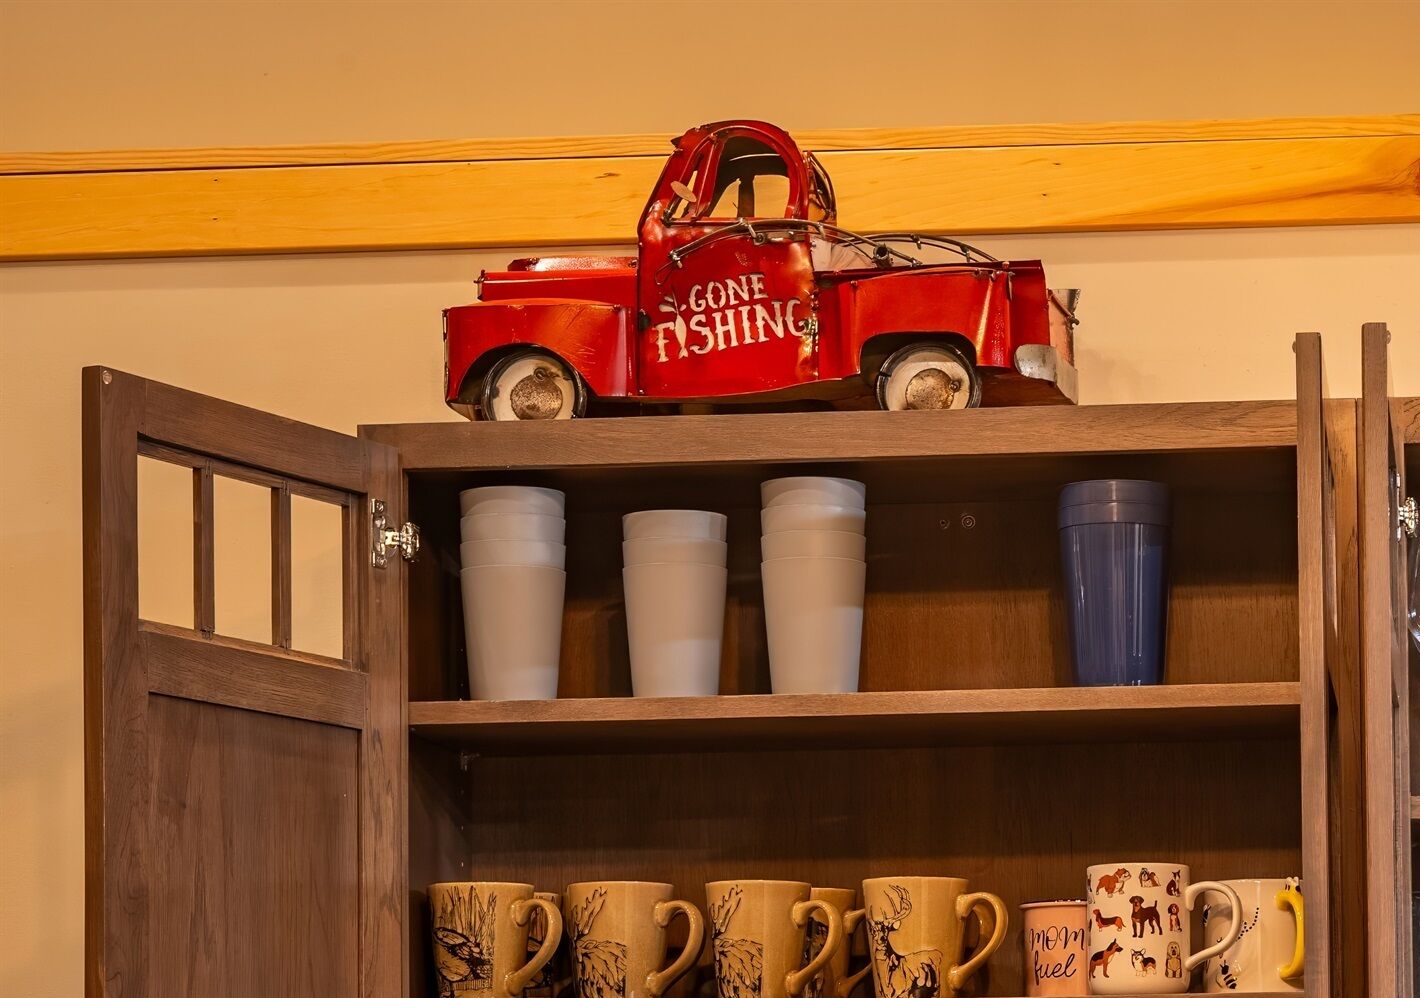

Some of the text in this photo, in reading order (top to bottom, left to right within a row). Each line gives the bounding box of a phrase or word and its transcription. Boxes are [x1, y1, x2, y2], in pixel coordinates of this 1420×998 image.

[689, 273, 768, 312] GONE
[655, 299, 807, 363] FISHING
[1034, 950, 1077, 986] fuel
